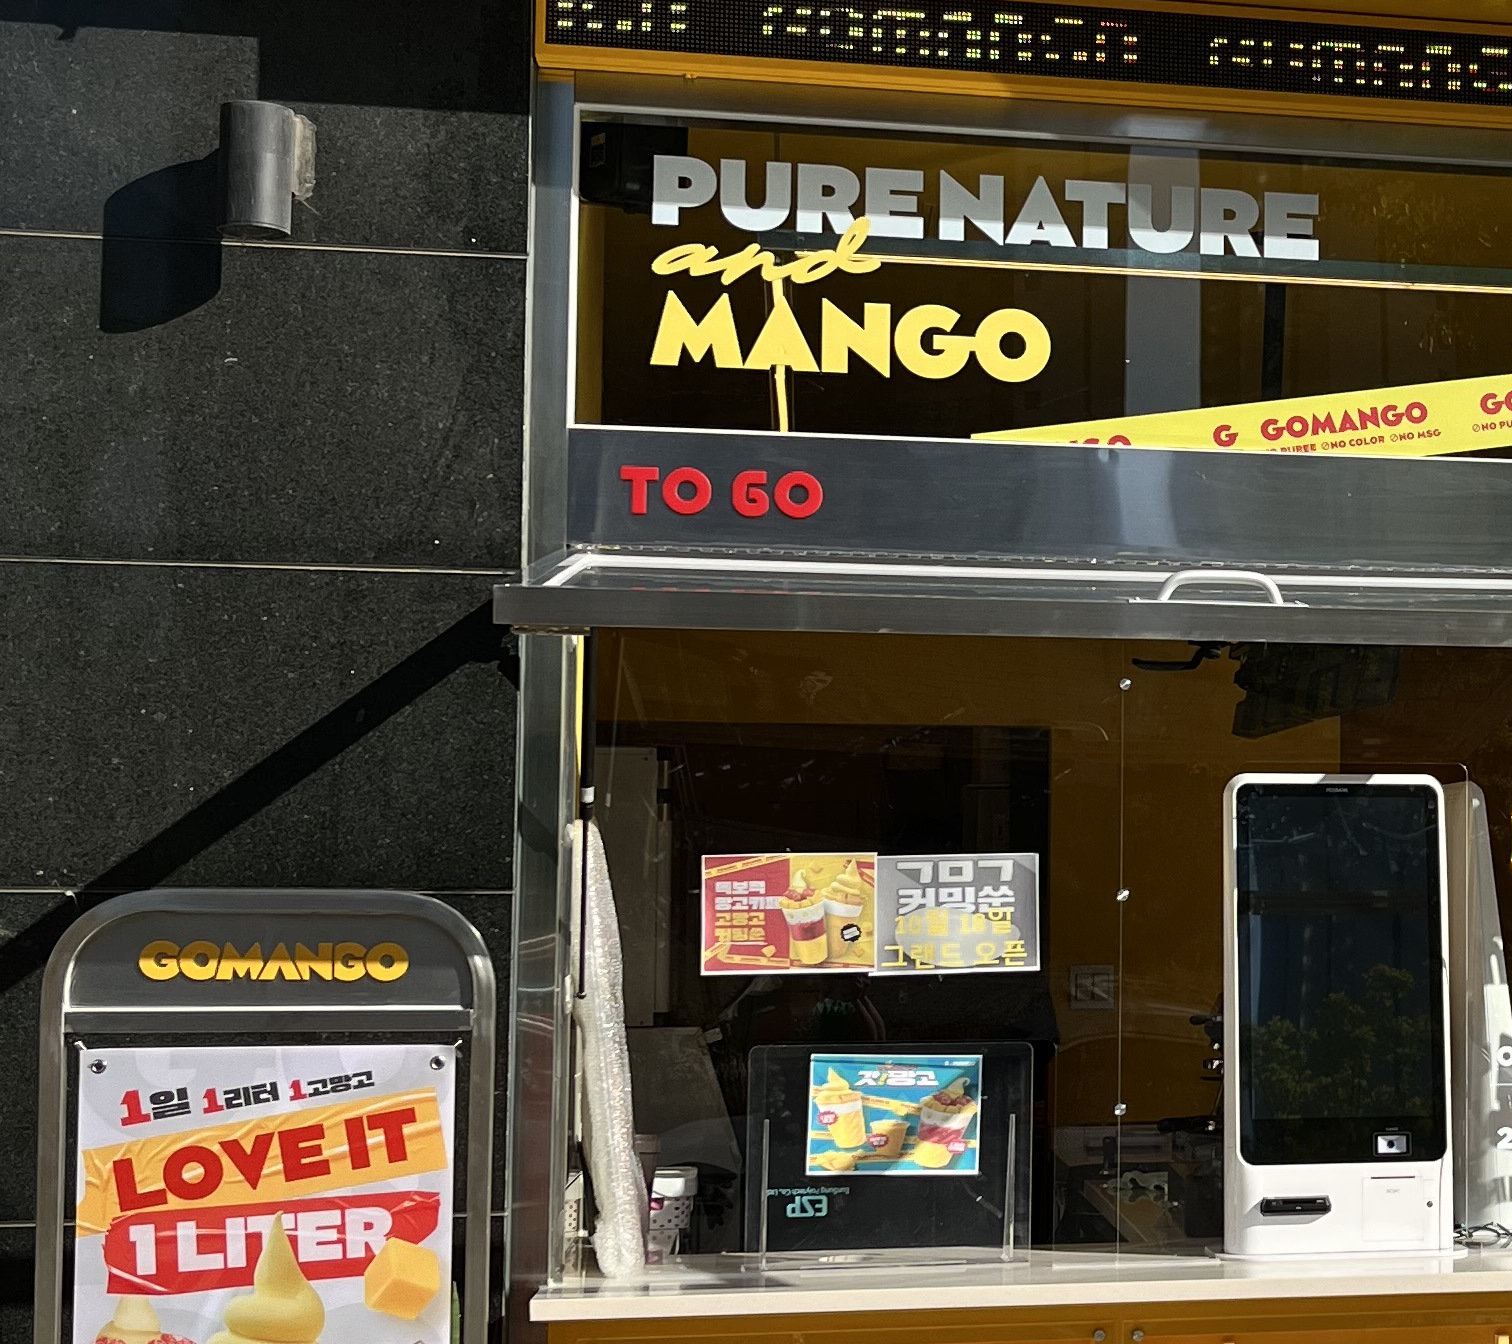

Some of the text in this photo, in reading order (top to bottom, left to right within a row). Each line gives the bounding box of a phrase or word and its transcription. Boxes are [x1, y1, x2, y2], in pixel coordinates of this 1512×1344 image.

[650, 216, 882, 285] and
[650, 290, 1053, 383] MANGO
[1260, 401, 1428, 441] GOMANGO
[1330, 428, 1442, 449] NO COLOR NO MSG
[1482, 421, 1497, 433] NO
[620, 464, 825, 518] TO GO
[138, 940, 409, 982] GOMANGO
[119, 1070, 375, 1127] 1일 1리터 1고망고
[112, 1106, 417, 1214] LOVE IT
[129, 1223, 158, 1276] 1
